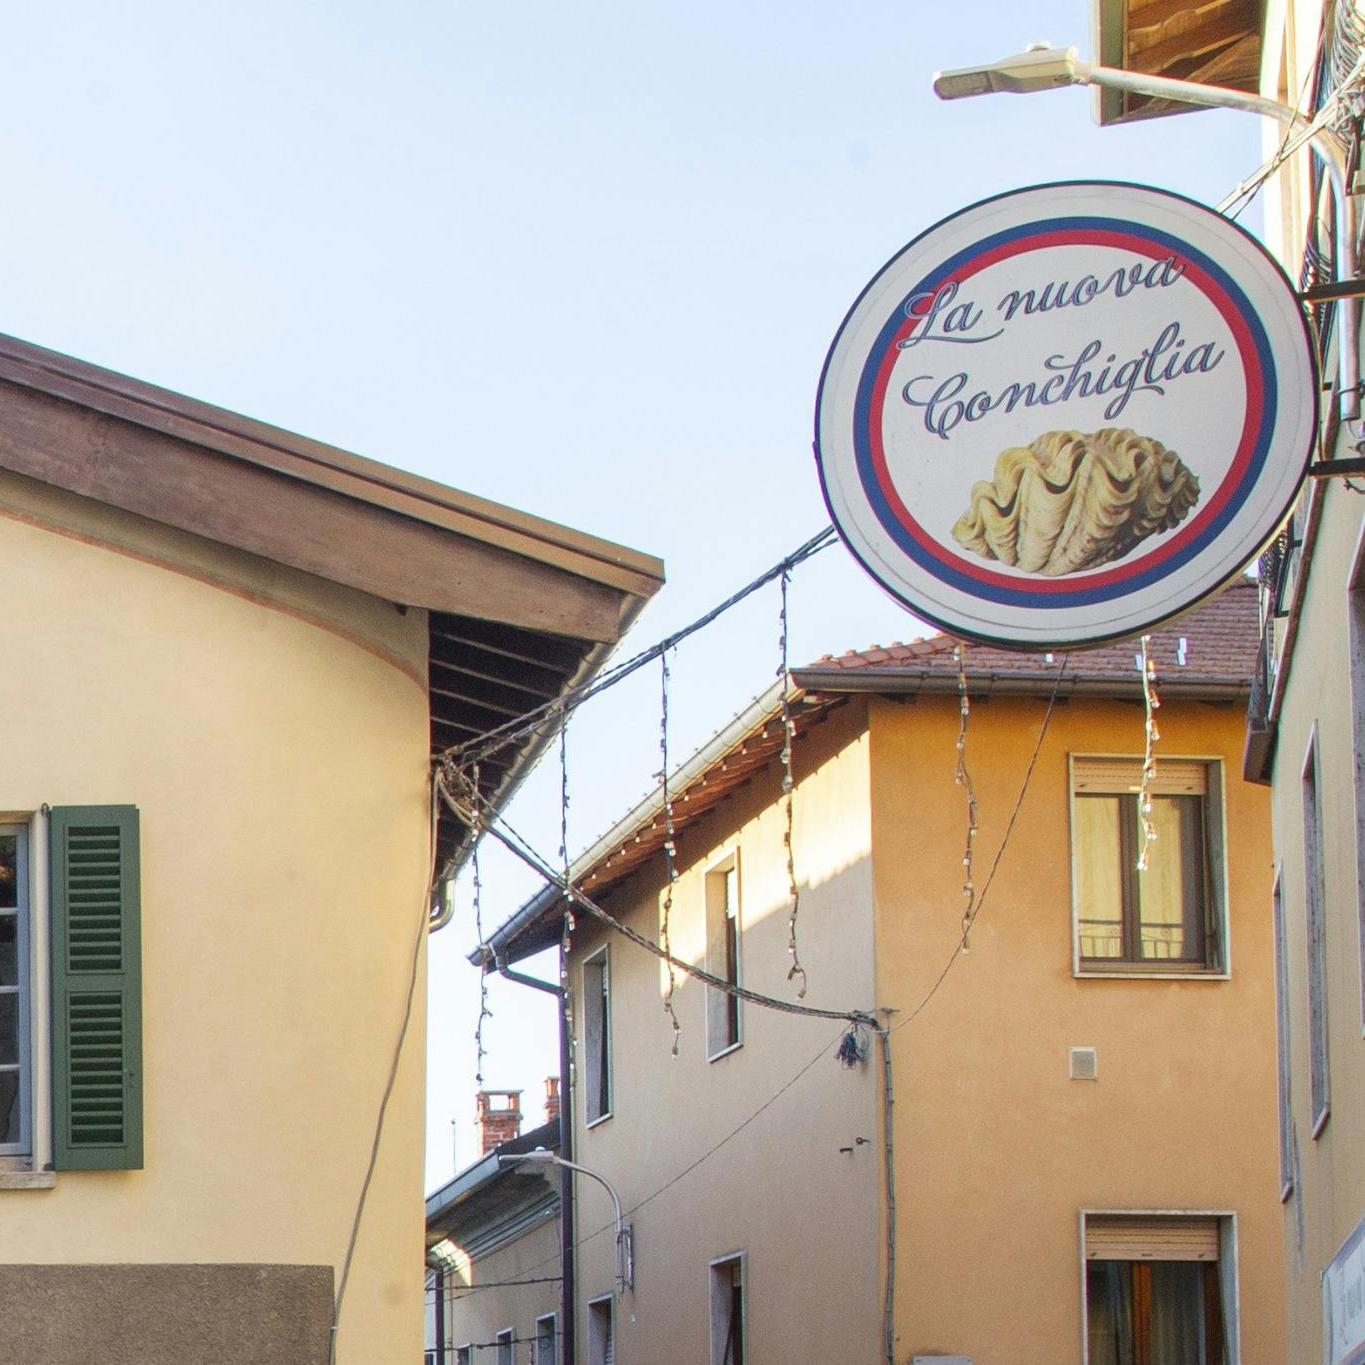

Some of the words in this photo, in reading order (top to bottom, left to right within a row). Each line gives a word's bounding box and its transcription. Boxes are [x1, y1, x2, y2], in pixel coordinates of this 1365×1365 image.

[897, 280, 1004, 349] La
[997, 256, 1185, 322] nuova
[902, 320, 1225, 440] Conchiglia
